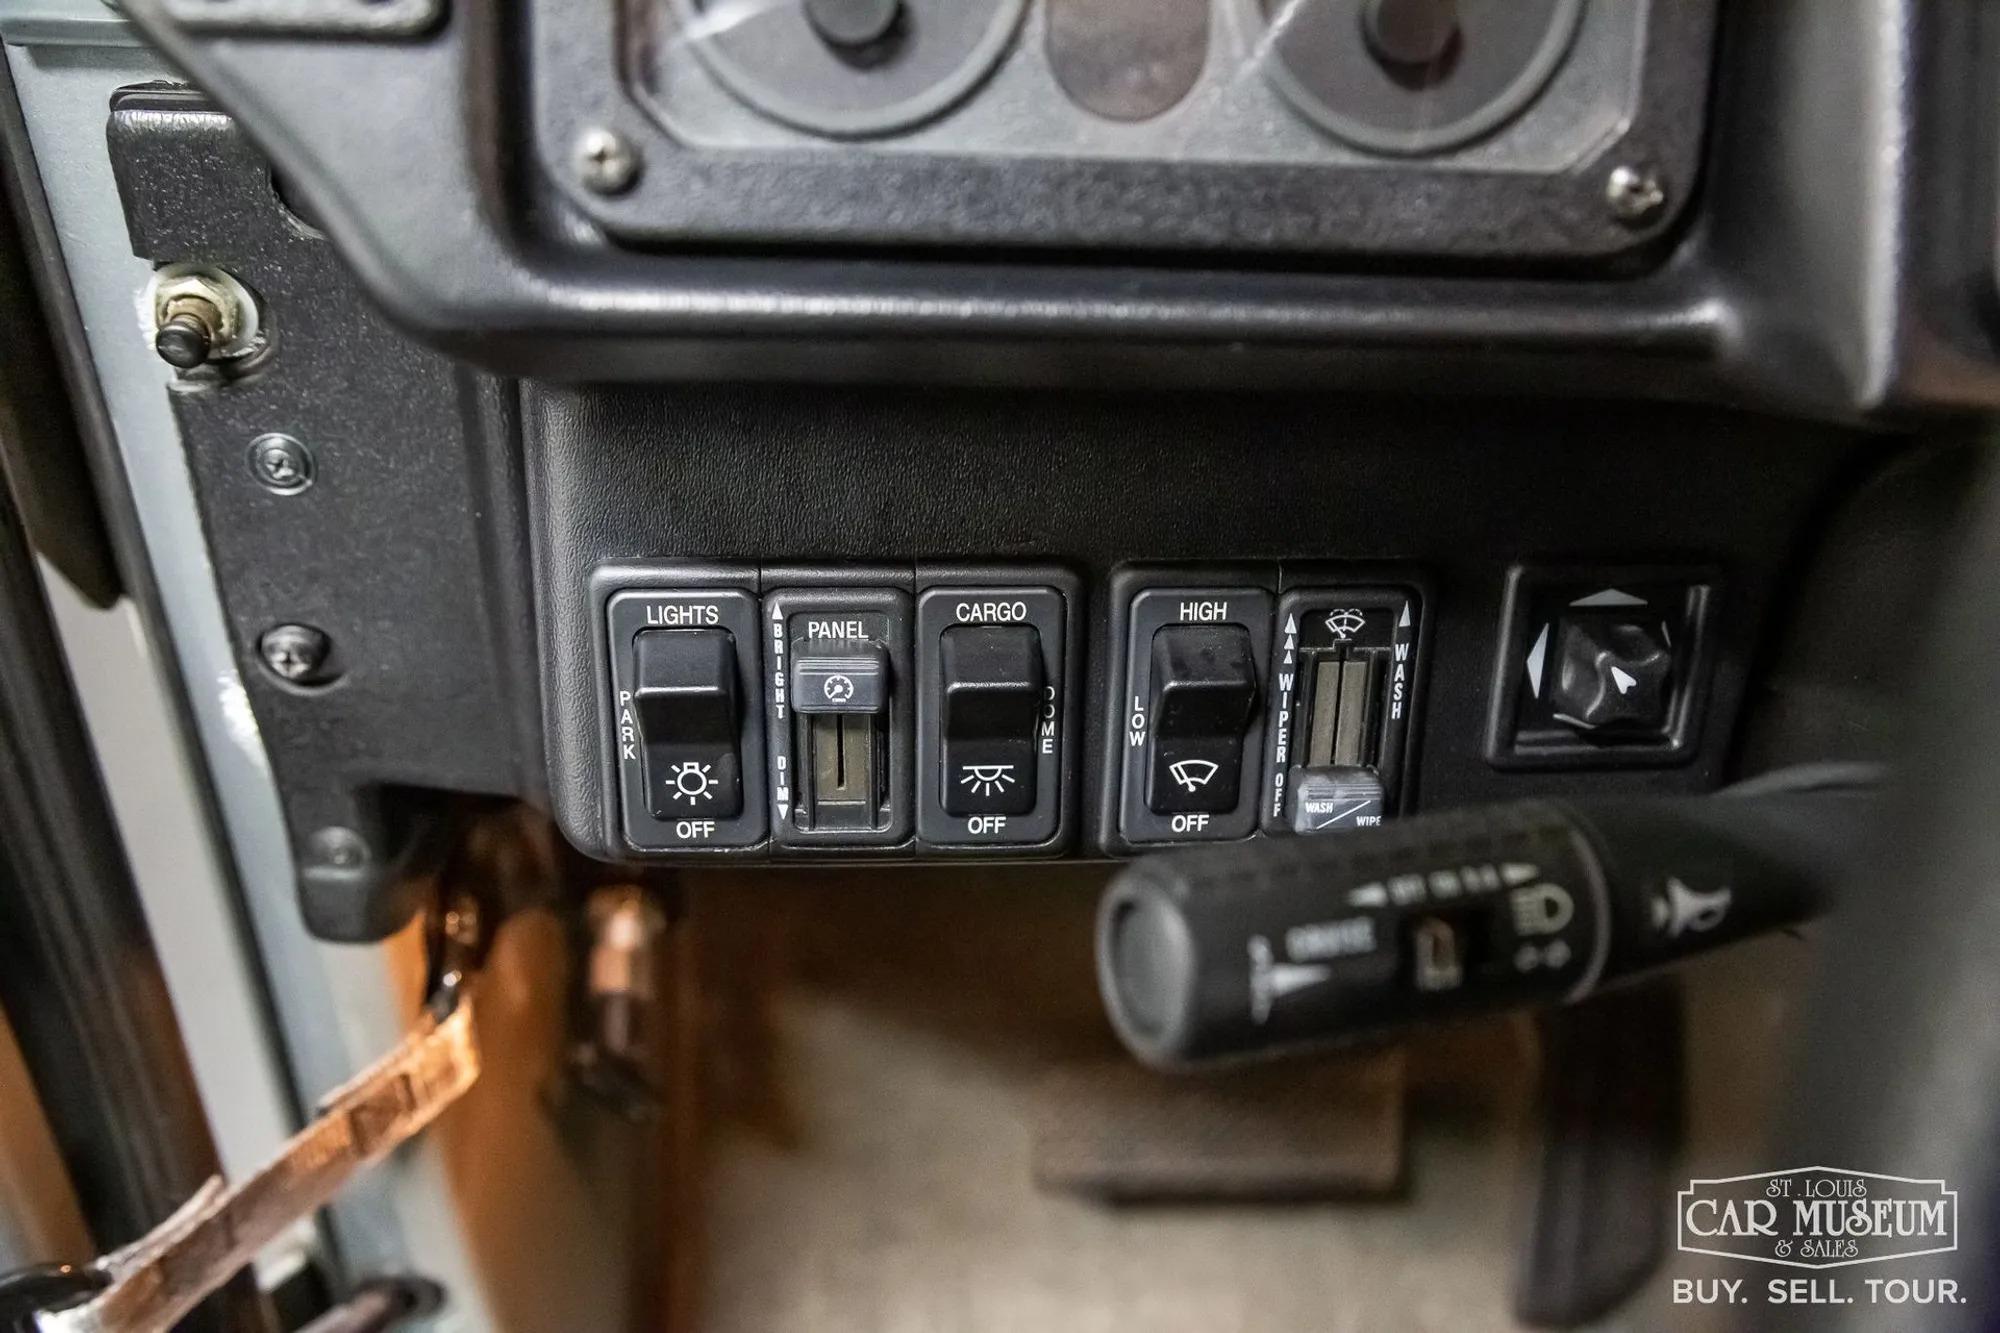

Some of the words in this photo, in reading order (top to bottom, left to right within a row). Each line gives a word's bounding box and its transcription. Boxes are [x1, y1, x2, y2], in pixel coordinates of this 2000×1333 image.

[646, 605, 720, 625] LIGHTS
[955, 601, 1027, 622] CARGO
[1179, 602, 1227, 621] HIGH
[807, 620, 870, 640] PANEL
[772, 622, 786, 720] BRIGHT
[1391, 643, 1410, 720] WASH
[619, 690, 637, 760] PARK
[1129, 696, 1146, 746] LOW
[1275, 673, 1294, 763] WIPER
[776, 755, 790, 801] DIM
[1272, 773, 1285, 817] OFF
[1305, 802, 1334, 814] WASH
[675, 821, 716, 839] OFF
[967, 816, 1007, 834] OFF
[1171, 814, 1210, 833] OFF
[1356, 815, 1382, 827] WIPE
